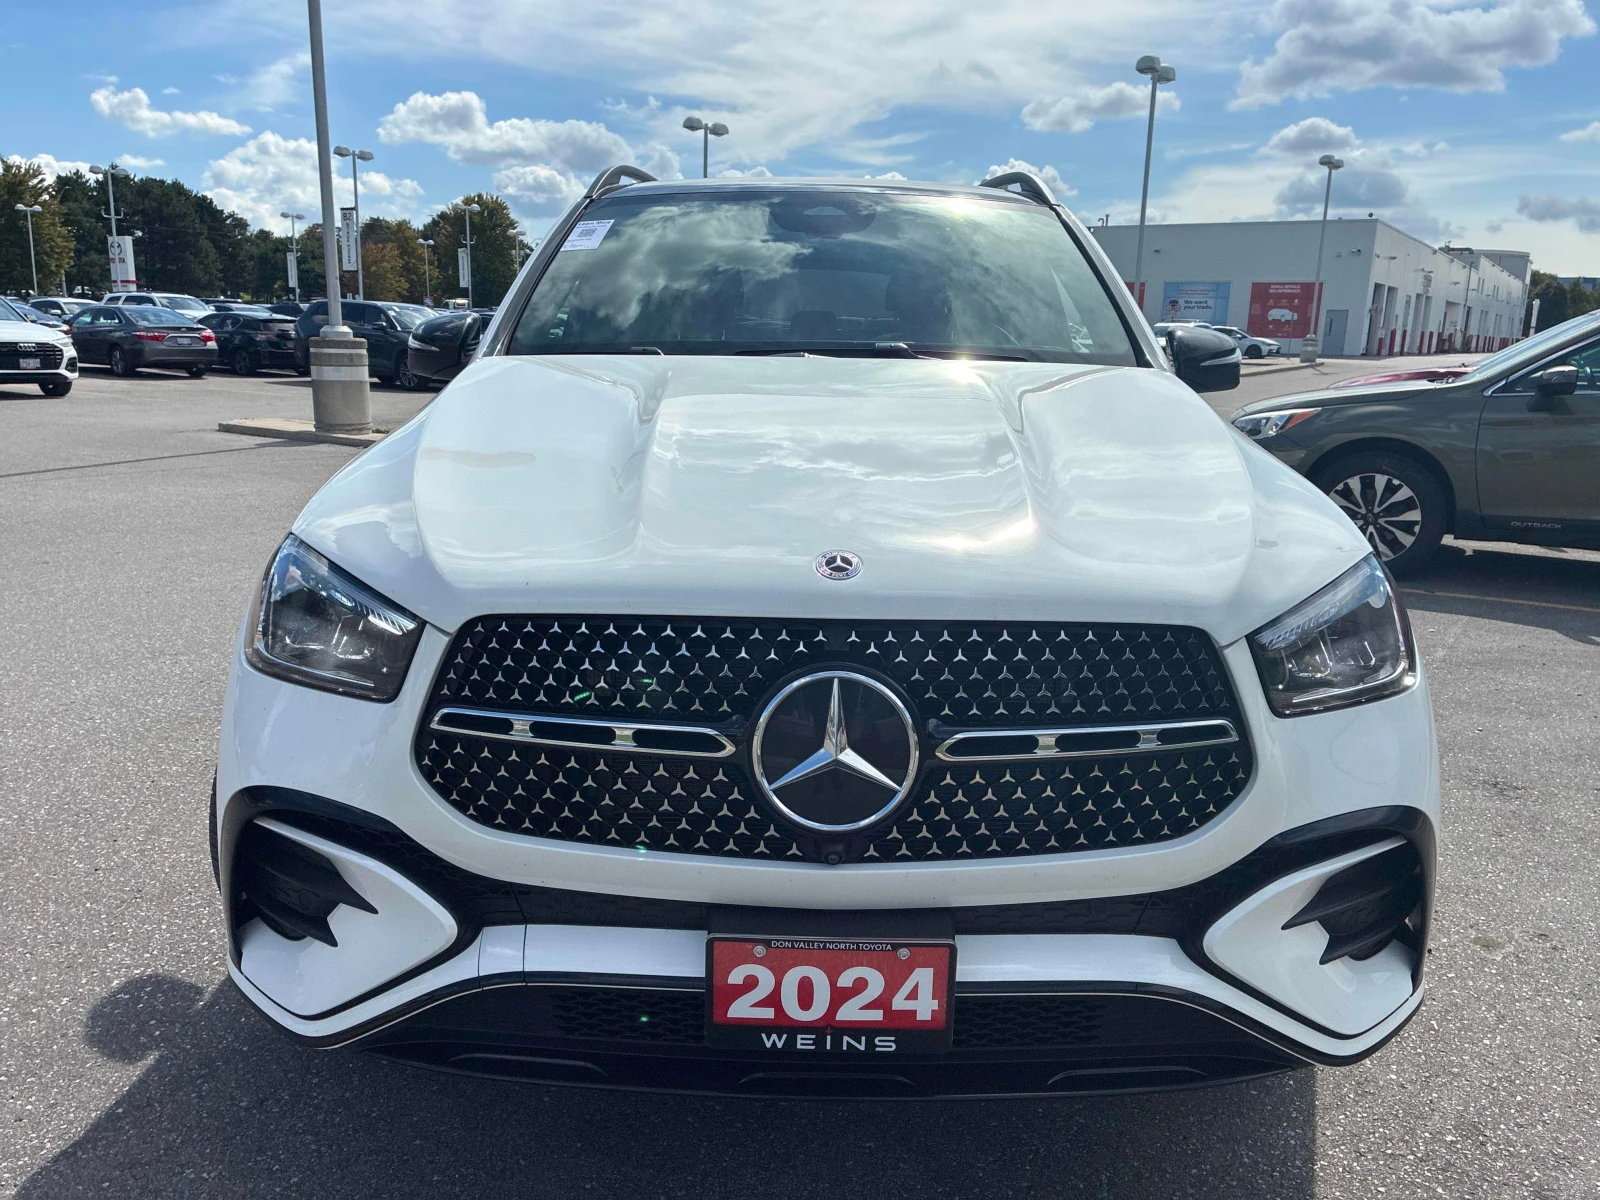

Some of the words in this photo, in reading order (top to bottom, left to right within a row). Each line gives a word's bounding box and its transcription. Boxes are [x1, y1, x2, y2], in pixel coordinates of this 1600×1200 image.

[1510, 521, 1562, 529] OUTBACK
[771, 940, 792, 949] DON
[793, 940, 825, 949] VALLEY
[826, 942, 857, 950] NORTH
[859, 943, 893, 951] TOYOTA
[726, 963, 939, 1022] 2024
[761, 1033, 897, 1052] WEINS
